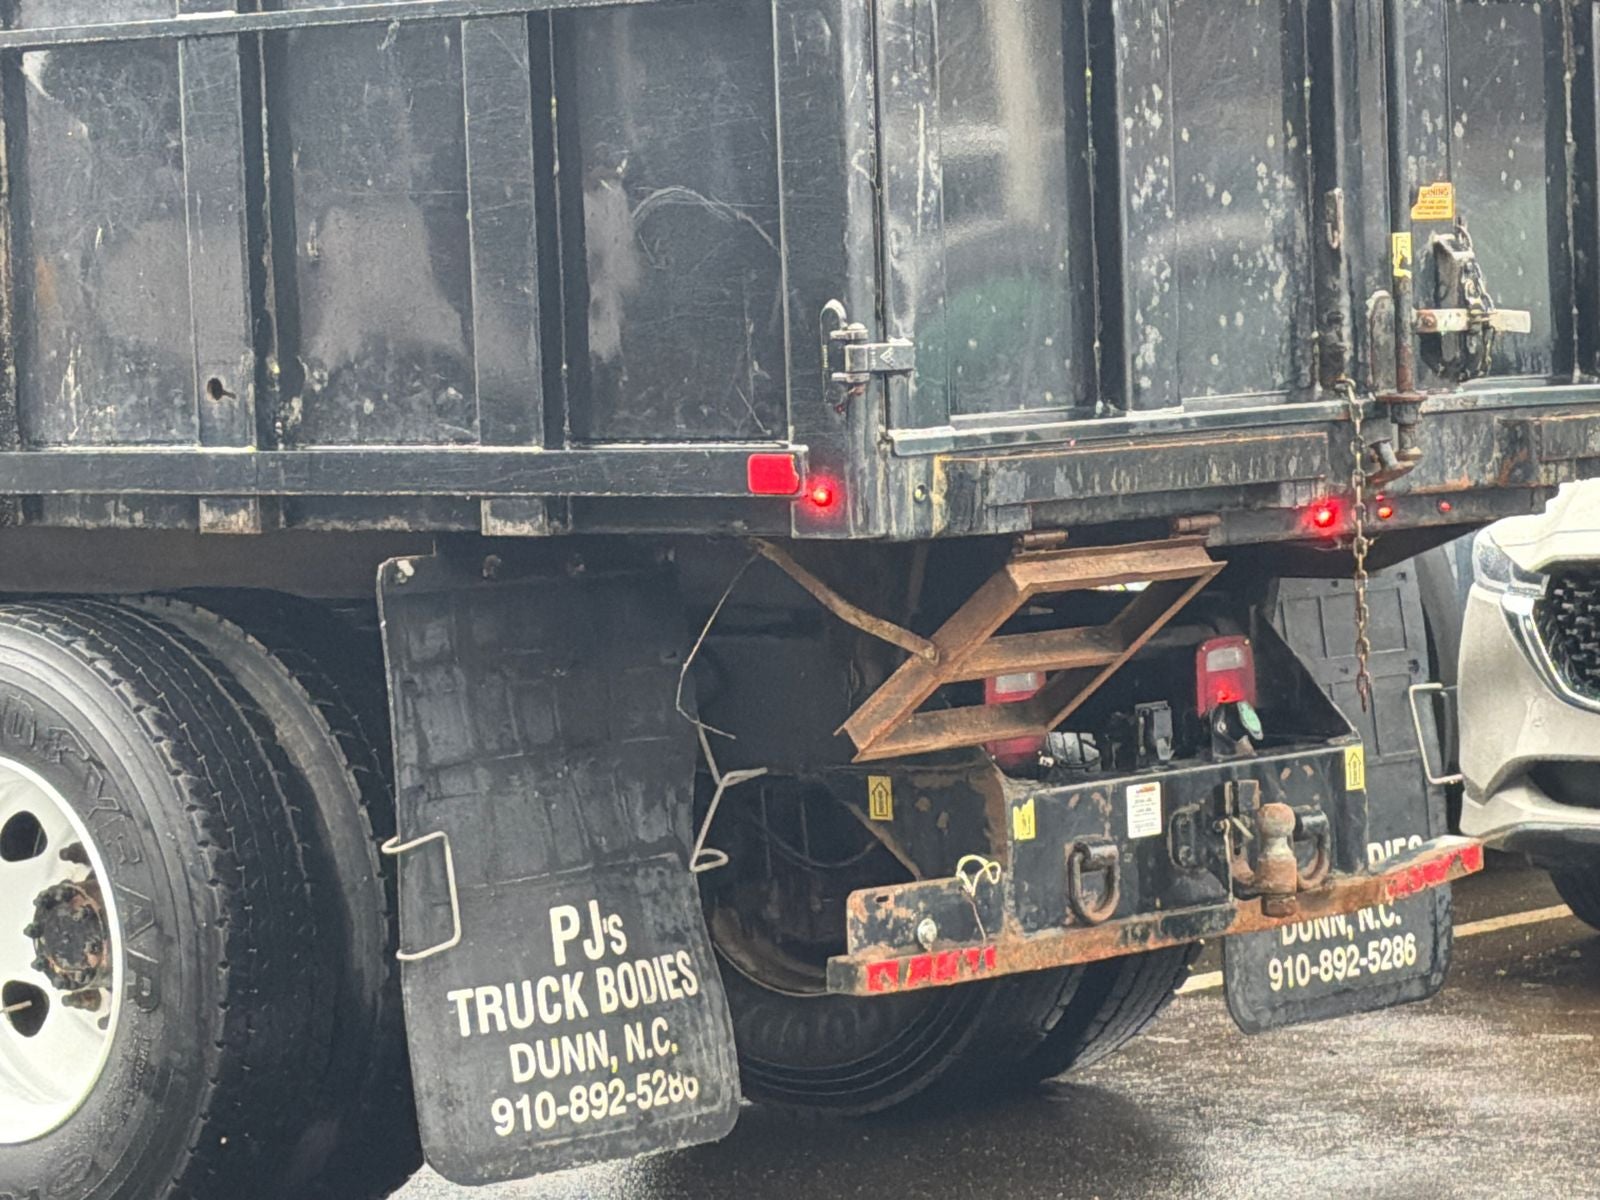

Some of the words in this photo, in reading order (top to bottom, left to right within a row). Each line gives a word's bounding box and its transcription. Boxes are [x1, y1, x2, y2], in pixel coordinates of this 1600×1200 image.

[447, 971, 589, 1037] TRUCK
[596, 950, 699, 1014] BODIES
[1269, 932, 1417, 992] 910-892-5286
[509, 1029, 618, 1083] DUNN,
[623, 1016, 678, 1063] N.C.
[491, 1069, 699, 1136] 910-892-5286
